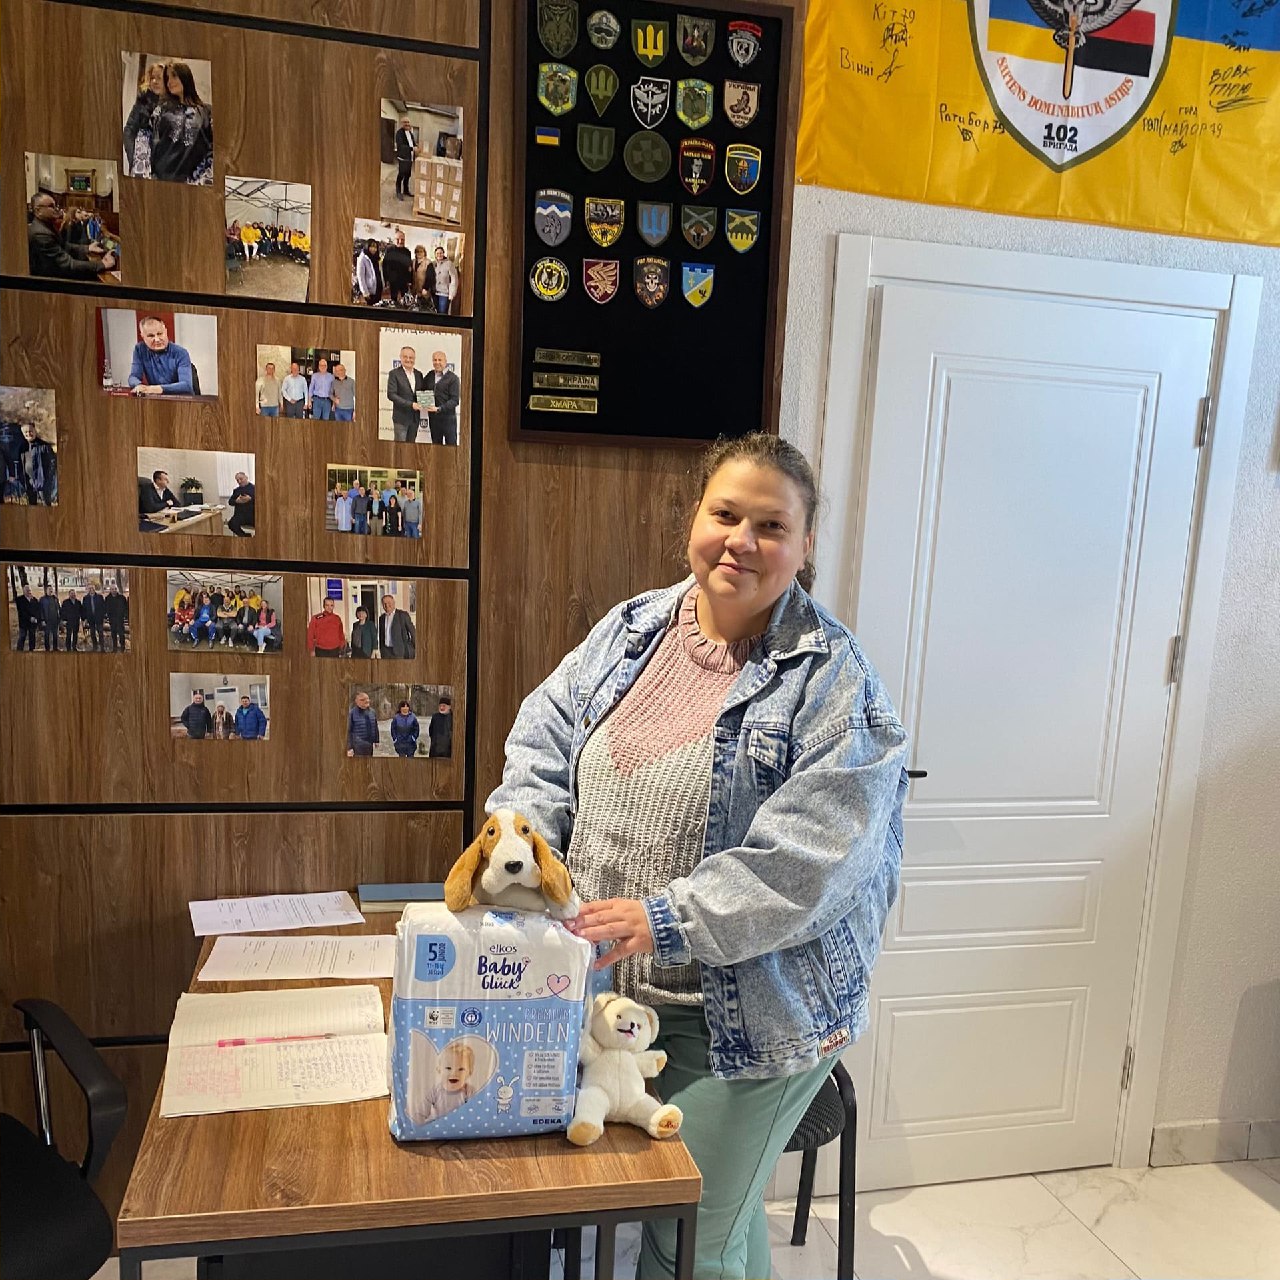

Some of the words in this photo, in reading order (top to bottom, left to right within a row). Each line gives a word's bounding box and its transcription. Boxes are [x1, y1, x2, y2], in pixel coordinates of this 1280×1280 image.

[1043, 122, 1079, 144] 102
[1042, 140, 1078, 152] БРИГАДА
[550, 400, 578, 409] ХМАРА
[428, 943, 437, 961] 5
[489, 944, 517, 955] elkos
[477, 955, 529, 982] Baby
[481, 974, 519, 990] Glück
[486, 1022, 570, 1043] WINDELN
